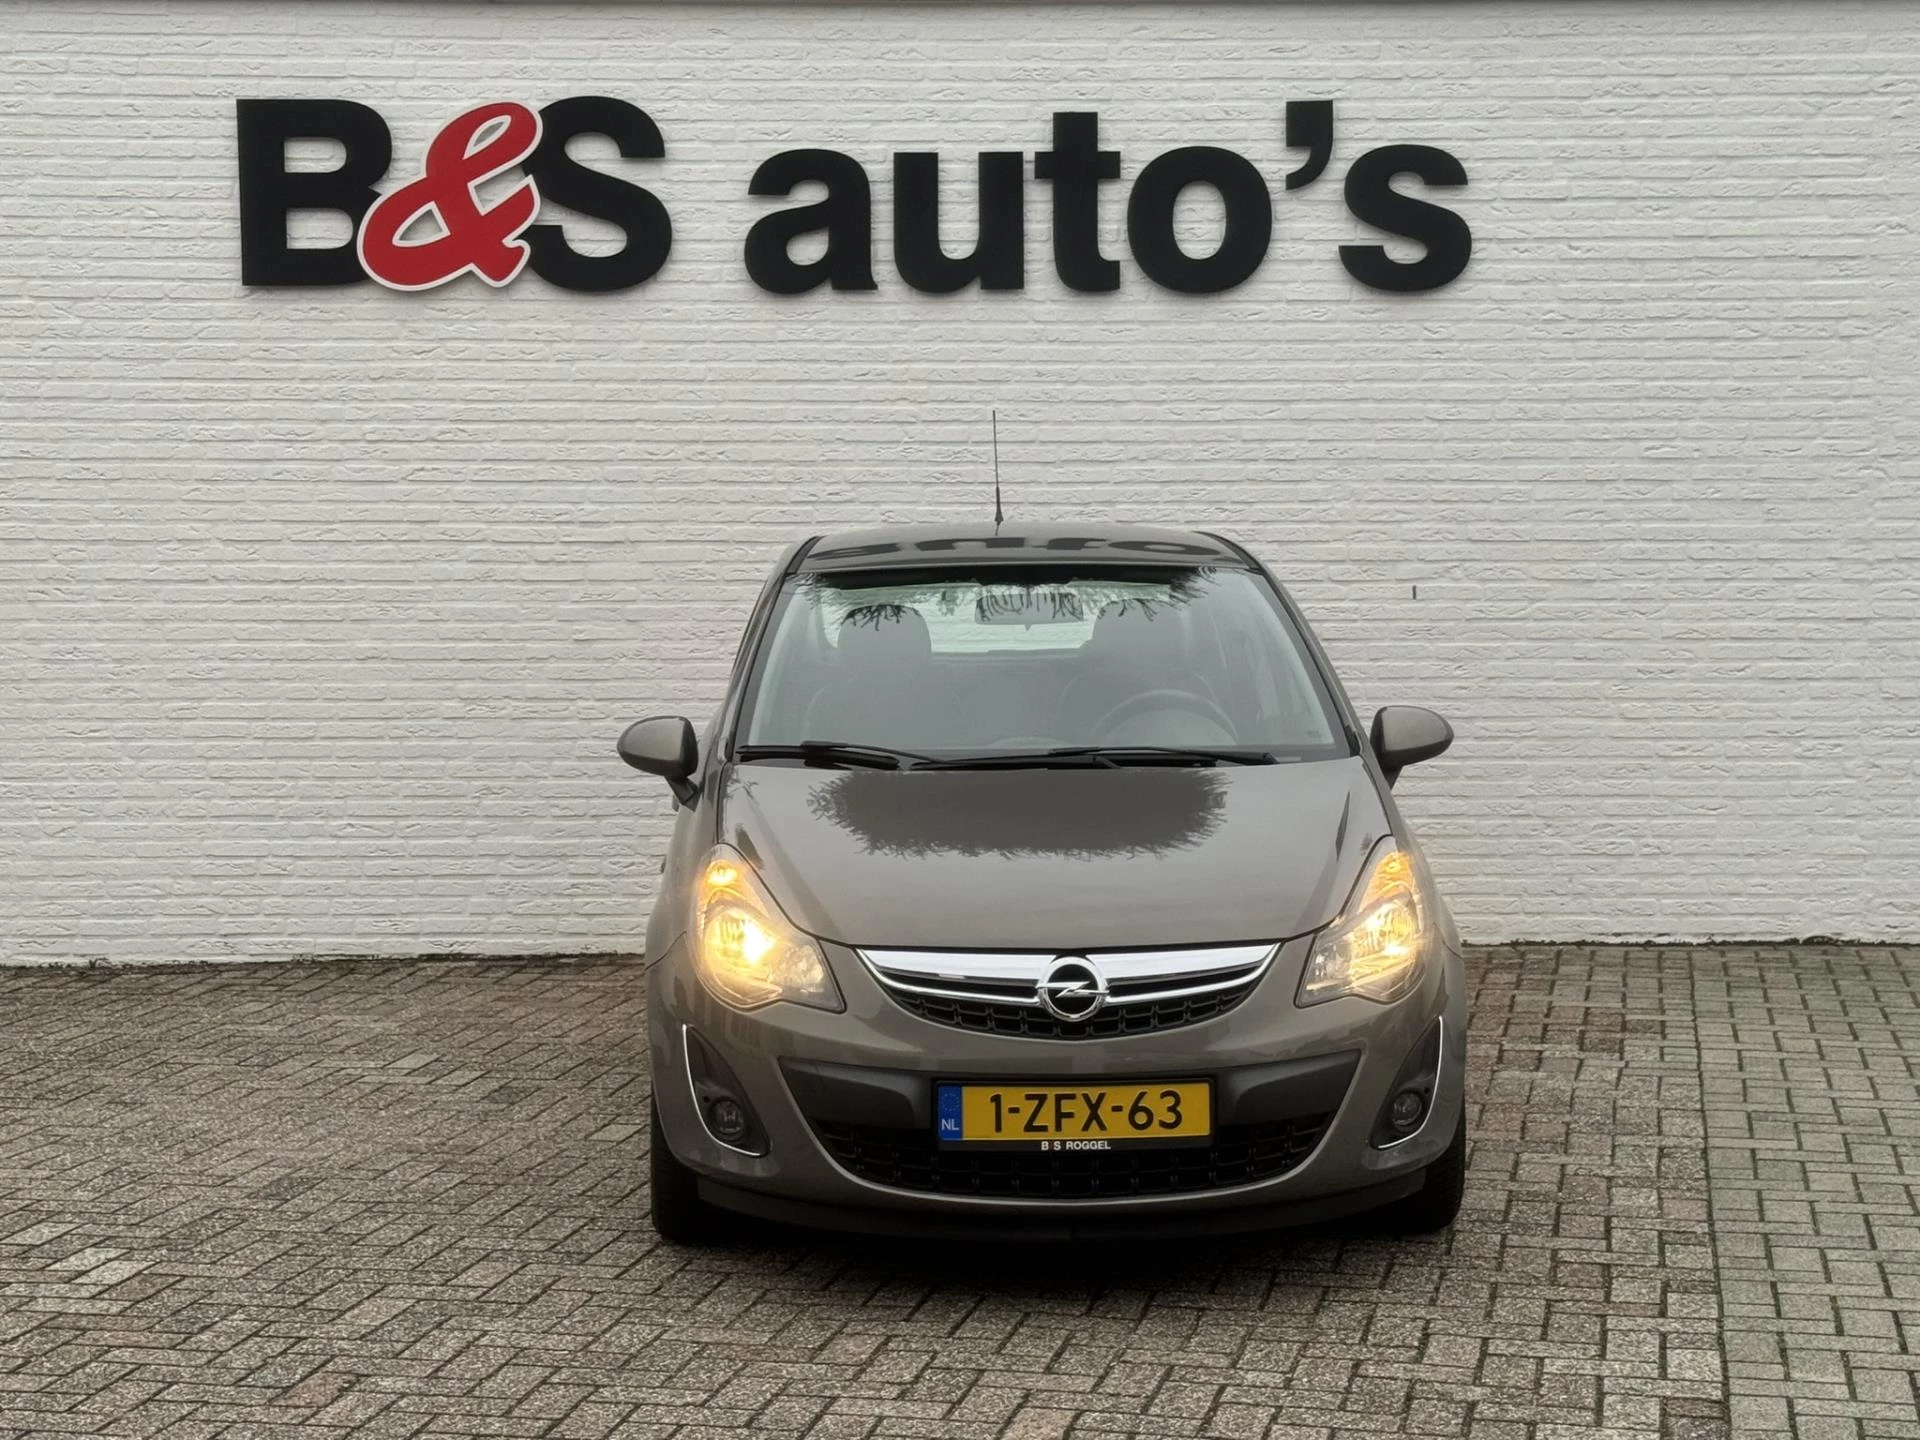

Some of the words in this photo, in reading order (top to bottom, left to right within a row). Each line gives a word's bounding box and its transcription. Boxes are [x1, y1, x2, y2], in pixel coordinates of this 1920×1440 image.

[236, 95, 673, 293] B&S
[744, 99, 1472, 294] auto's
[941, 1118, 960, 1131] NL
[989, 1089, 1183, 1133] 1-ZFX-63
[1041, 1141, 1049, 1151] B
[1053, 1141, 1062, 1151] S
[1065, 1140, 1112, 1151] ROGGEL
